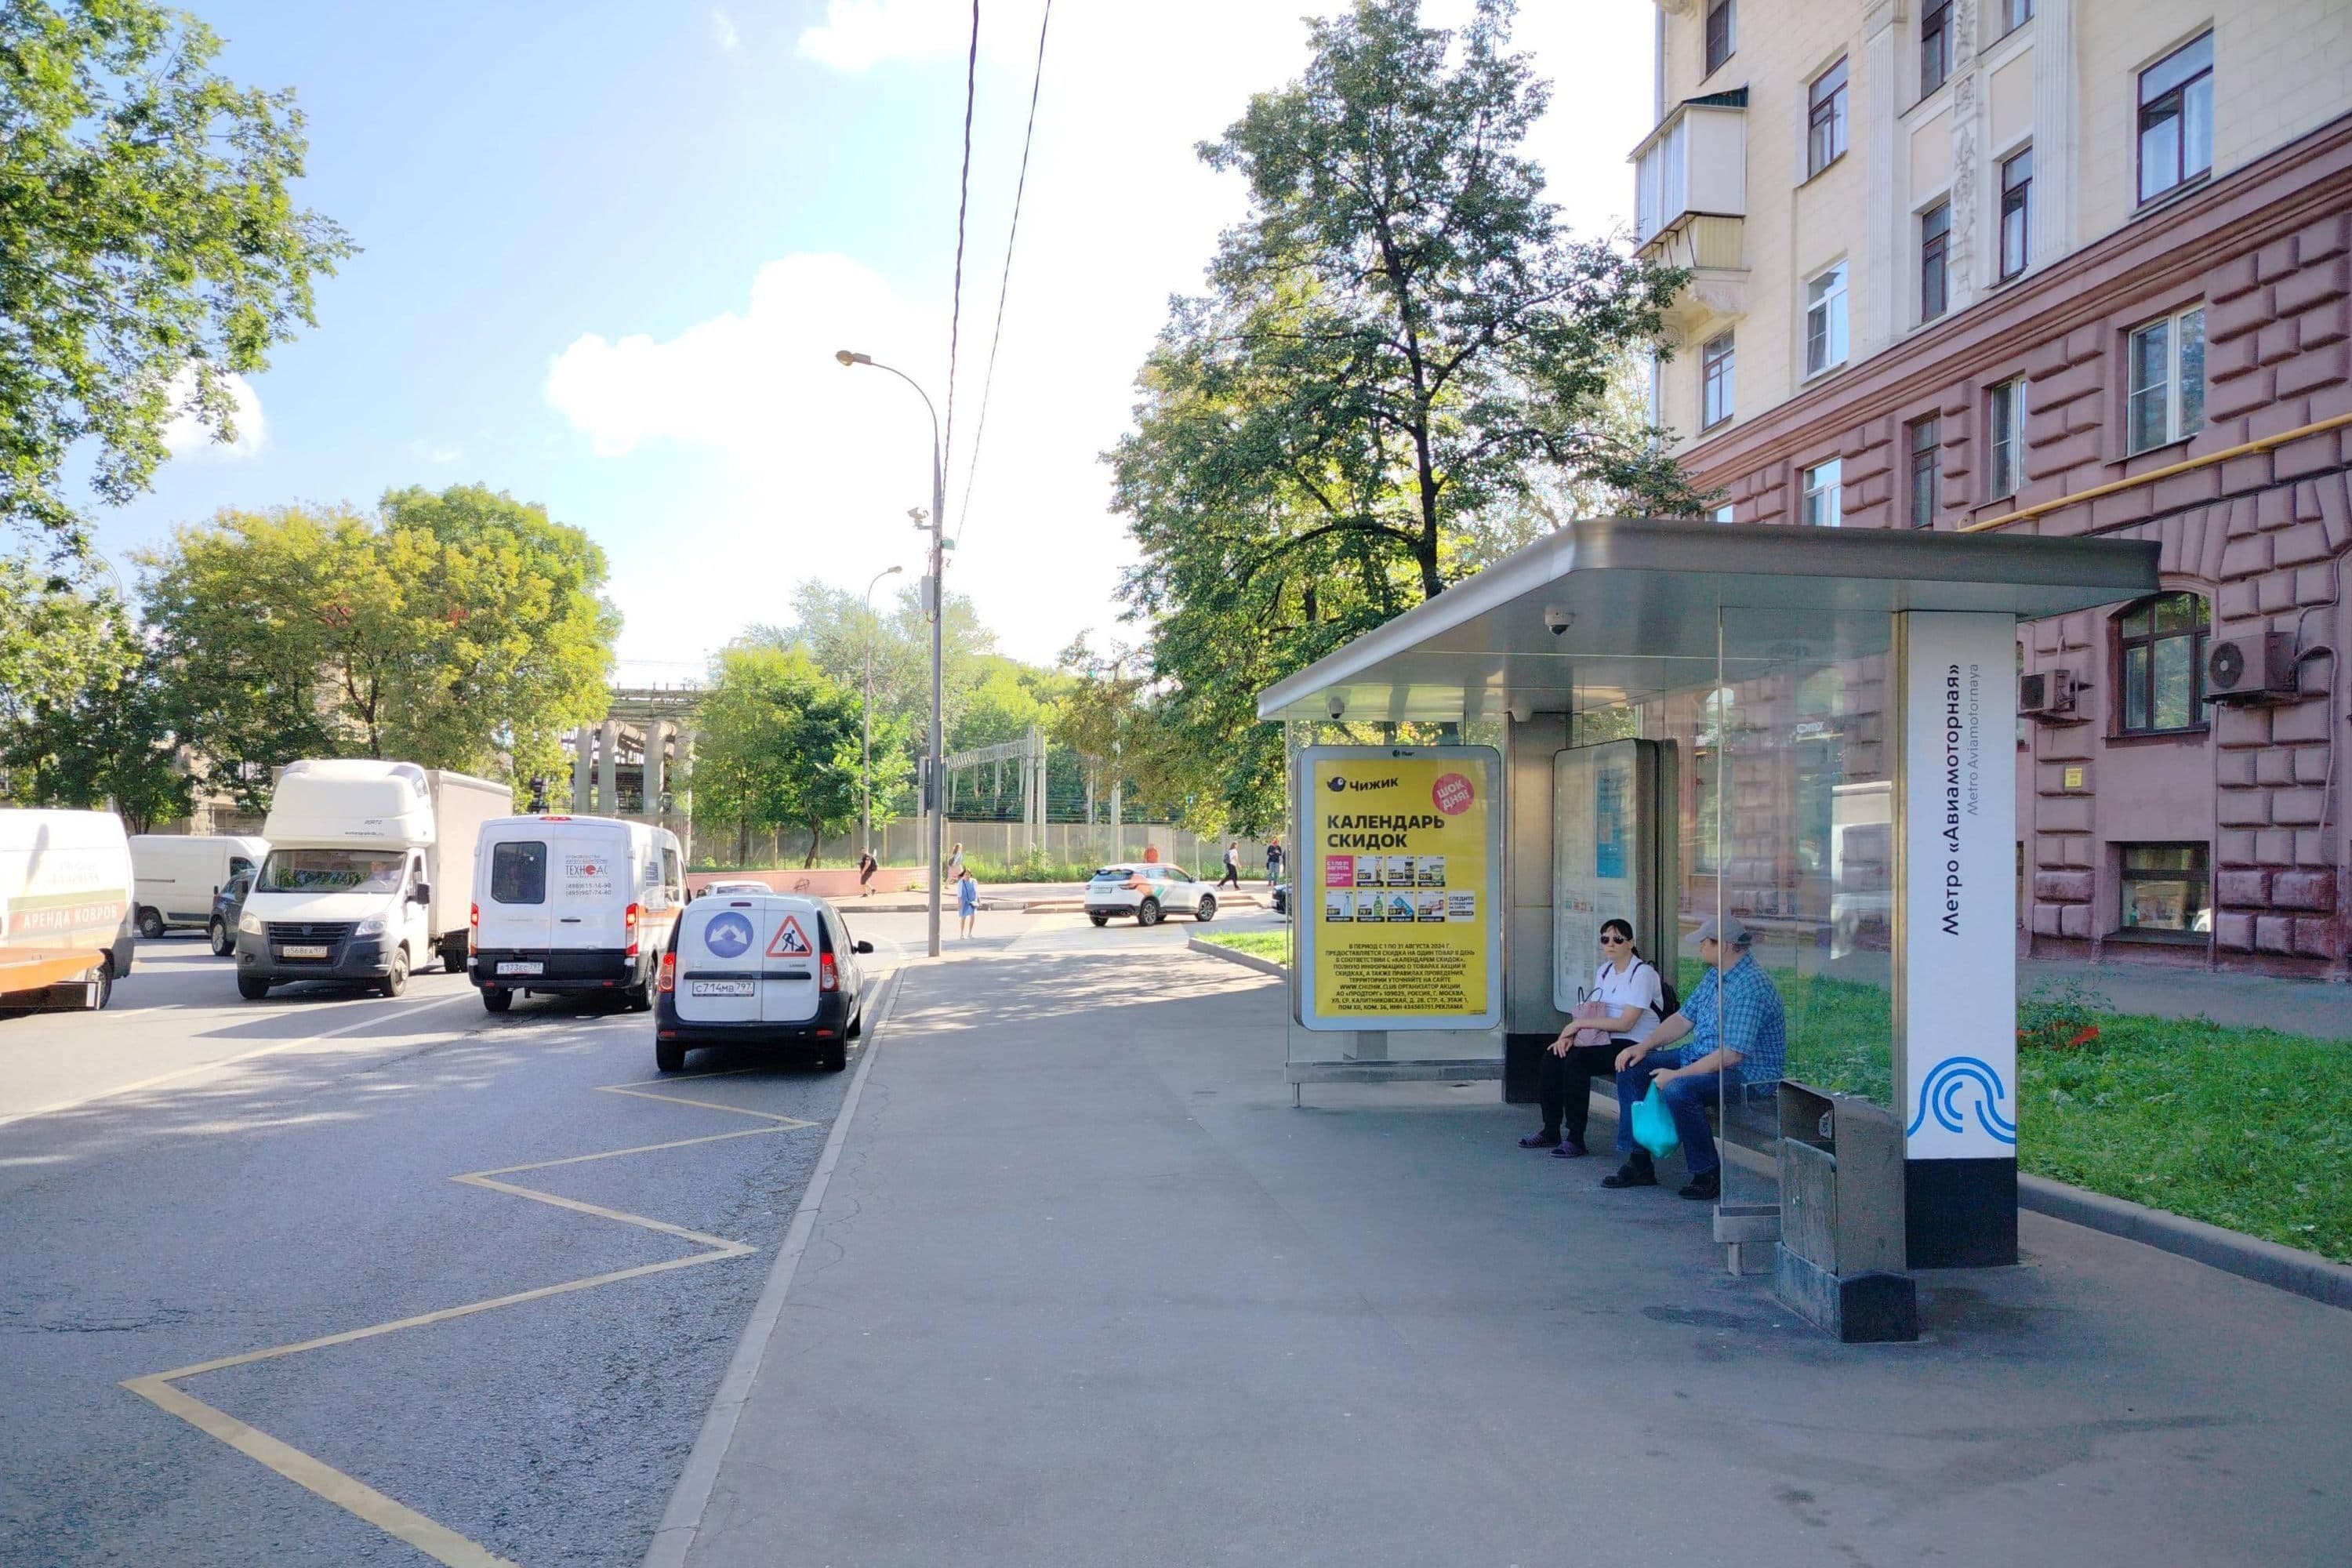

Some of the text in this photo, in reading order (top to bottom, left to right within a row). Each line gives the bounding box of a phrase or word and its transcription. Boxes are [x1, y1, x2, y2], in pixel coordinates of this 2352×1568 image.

[1967, 664, 1980, 815] Metro Aviamotornaya
[1436, 779, 1465, 799] ШОК
[1442, 789, 1471, 811] ДНЯ!
[1942, 664, 1963, 936] Метро «Авиамоторная»
[1327, 815, 1446, 831] КАЛЕНДАРЬ
[1327, 833, 1408, 850] СКИДОК
[24, 904, 118, 929] АРЕНДА КОВРОВ
